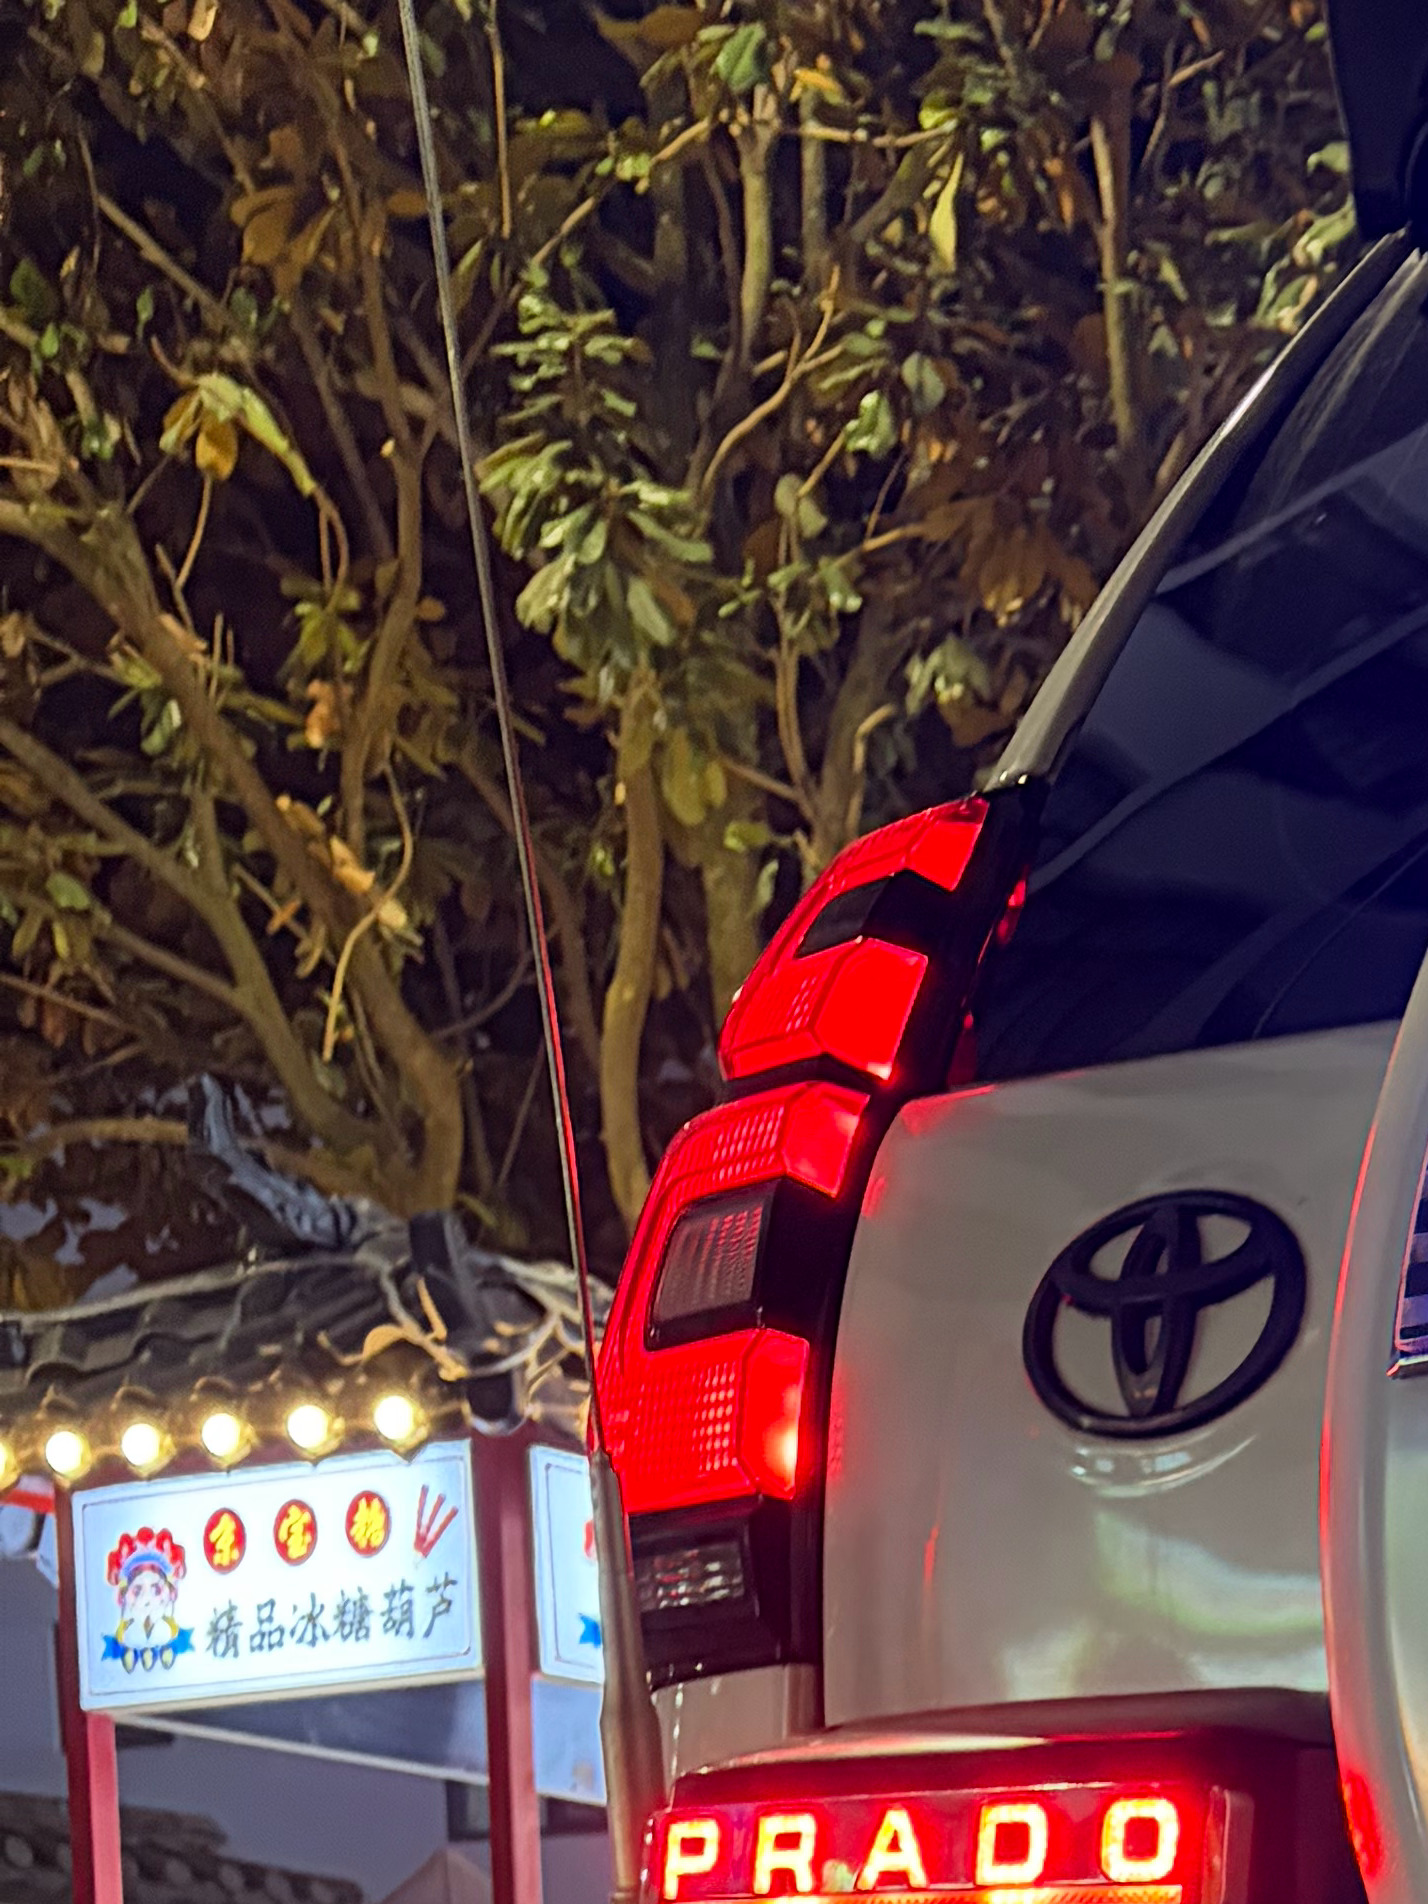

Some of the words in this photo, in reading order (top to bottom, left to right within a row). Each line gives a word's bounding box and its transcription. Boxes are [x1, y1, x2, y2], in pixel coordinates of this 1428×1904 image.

[204, 1570, 459, 1660] 精品冰糖葫芦
[663, 1796, 1180, 1901] PRADO
